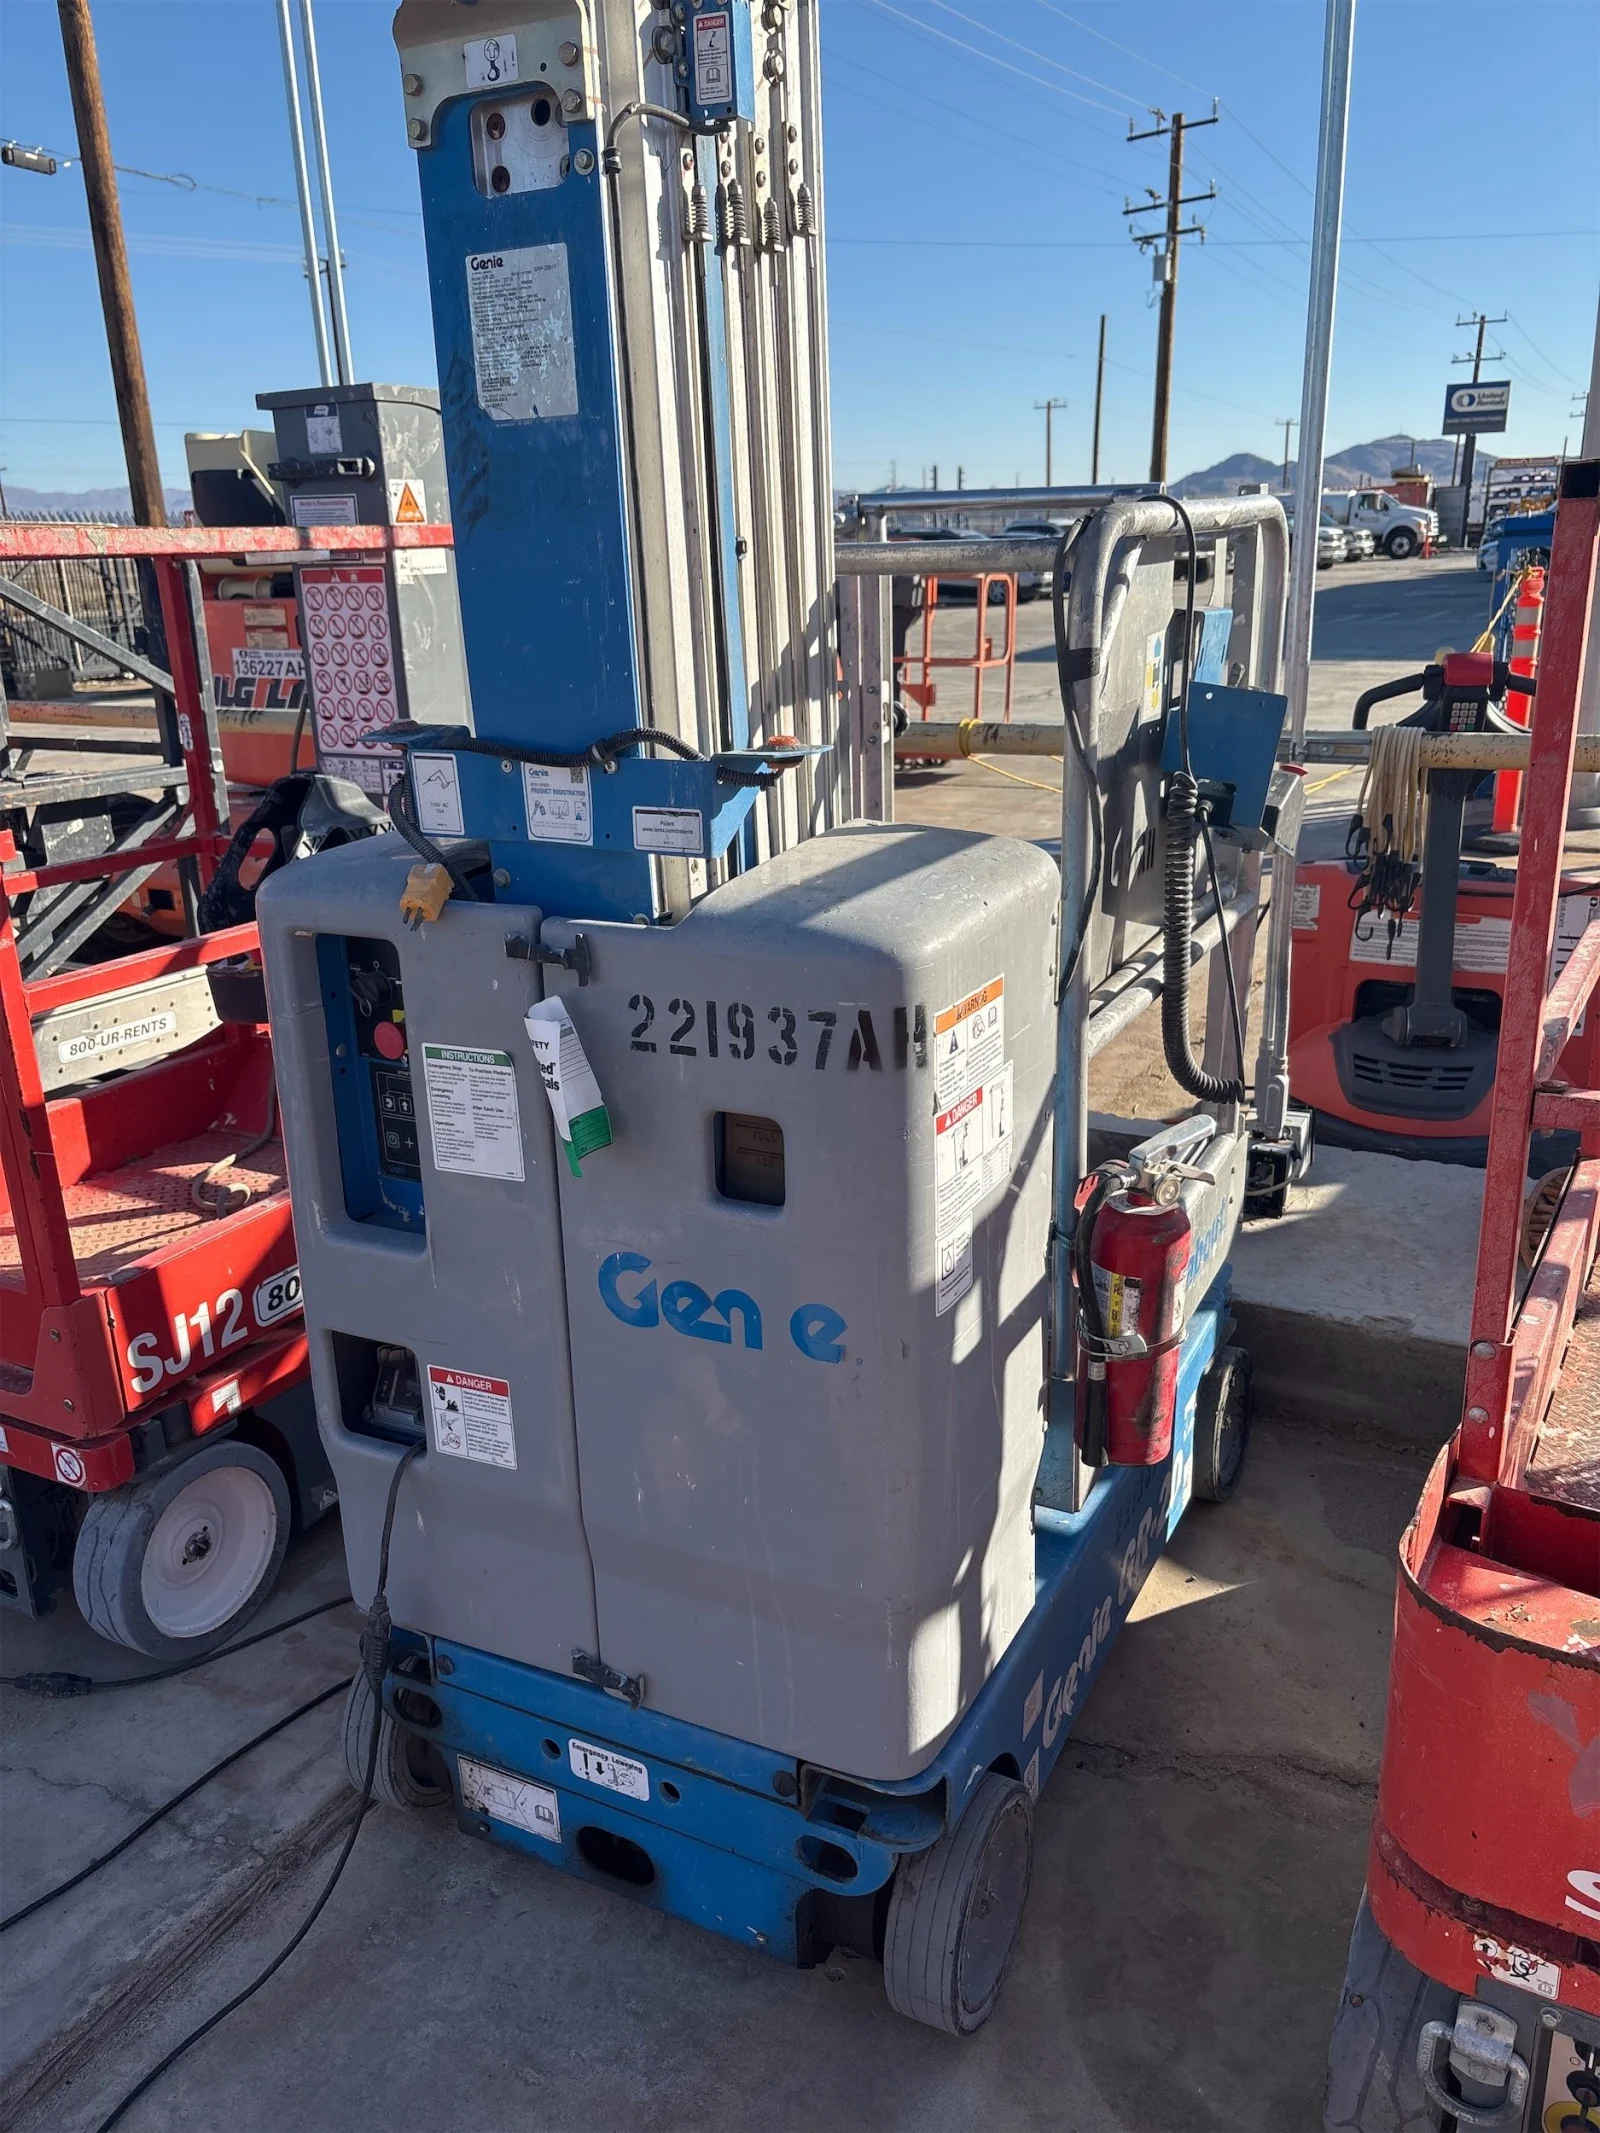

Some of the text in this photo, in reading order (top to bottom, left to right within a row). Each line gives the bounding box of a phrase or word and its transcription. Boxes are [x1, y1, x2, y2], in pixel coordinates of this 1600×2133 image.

[704, 18, 725, 27] DANGER
[470, 255, 504, 271] Genie
[1477, 391, 1505, 400] United
[528, 767, 549, 777] Genie
[552, 789, 587, 797] REGISTRATION
[69, 1017, 167, 1057] 800-UR-RENTS
[627, 994, 928, 1070] 221937AH
[441, 1049, 495, 1064] INSTRUCTIONS
[951, 1092, 978, 1123] DANGER
[126, 1288, 249, 1394] SJ12
[455, 1375, 492, 1391] DANGER
[1043, 1595, 1113, 1750] Genie
[571, 1741, 609, 1762] Emergency
